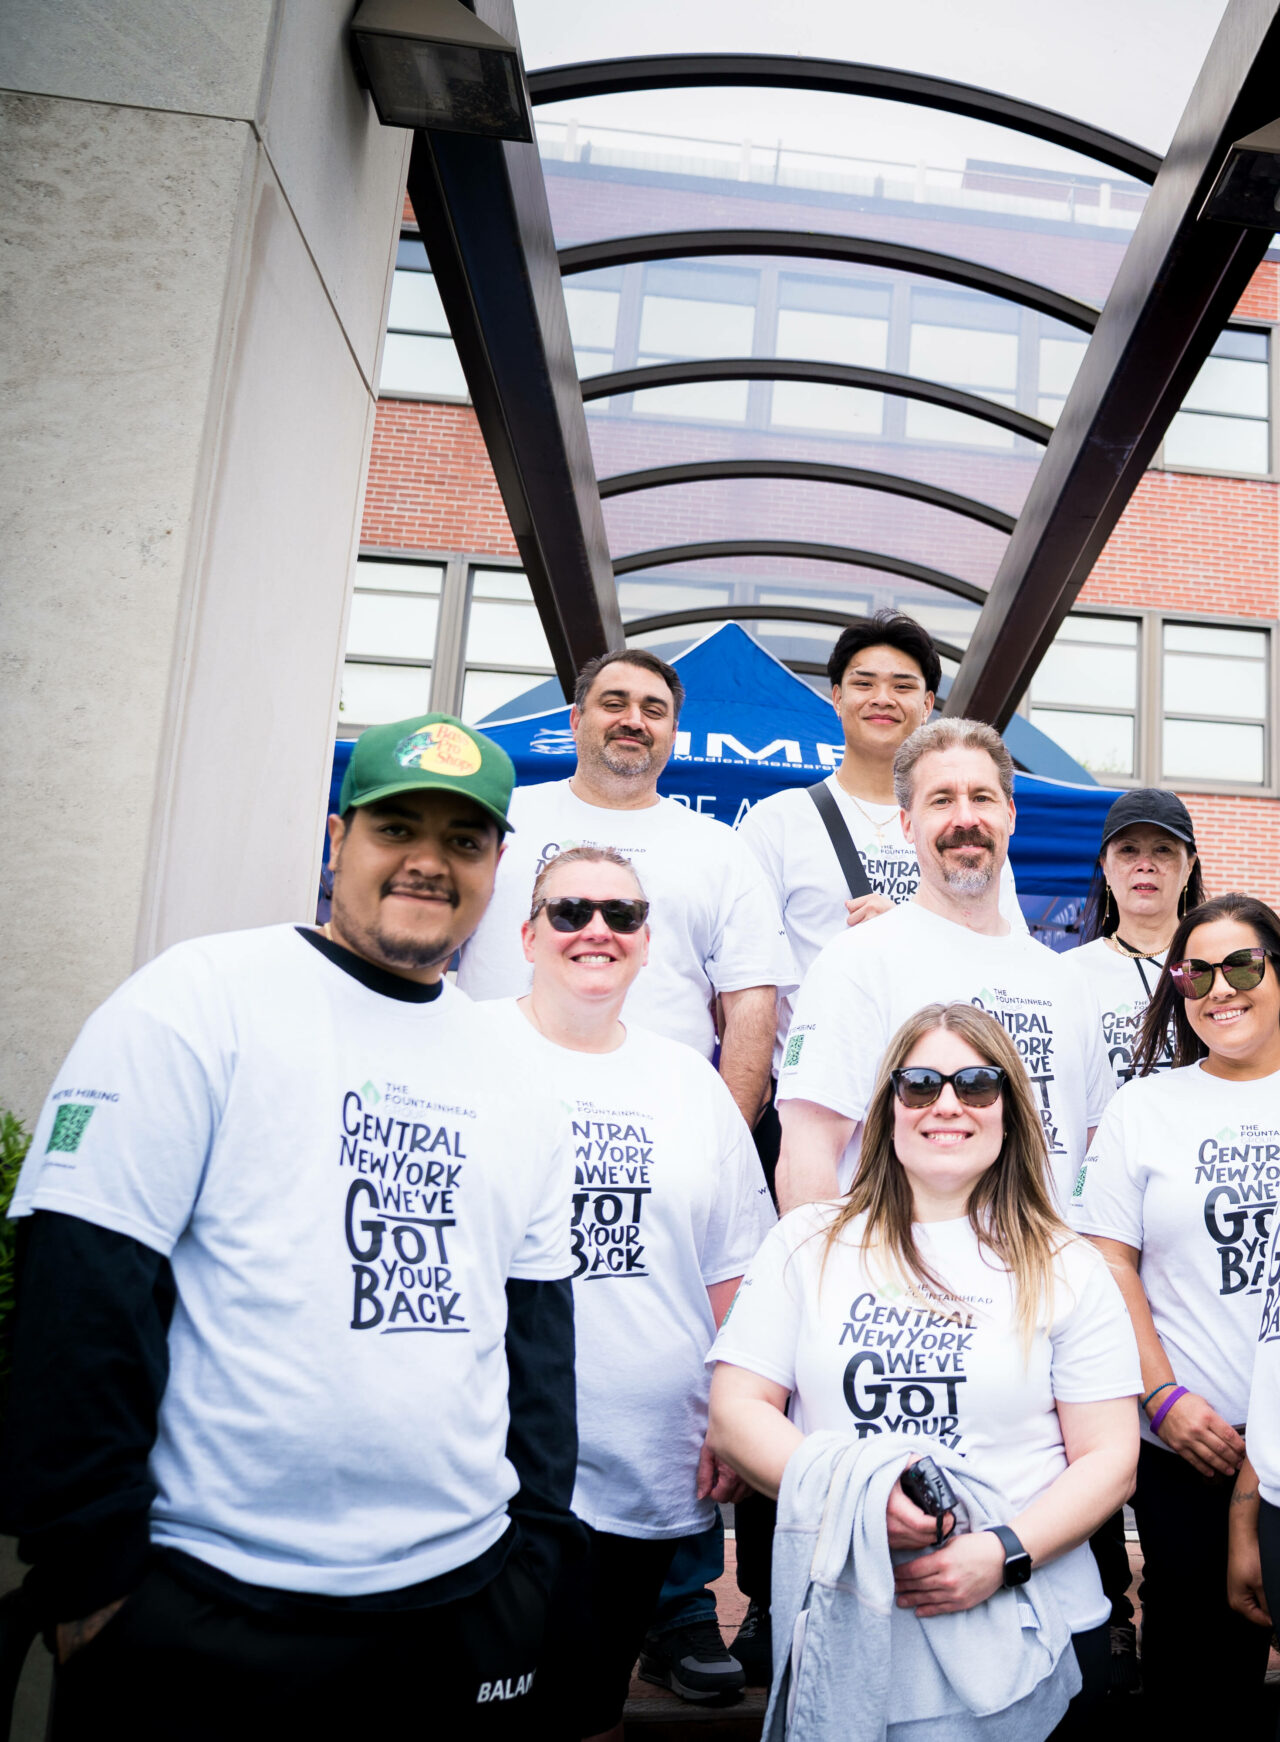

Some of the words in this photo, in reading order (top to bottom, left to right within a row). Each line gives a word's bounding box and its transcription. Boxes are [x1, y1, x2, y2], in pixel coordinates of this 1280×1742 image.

[674, 755, 750, 765] Medical
[858, 851, 920, 878] ENTRA
[993, 988, 1007, 996] THE
[1011, 1034, 1055, 1056] ORK
[386, 1082, 409, 1095] THE
[342, 1090, 467, 1160] CENTRAL
[571, 1120, 654, 1144] NTRAL
[583, 1161, 650, 1185] WE'VE
[379, 1179, 454, 1214] WE'VE
[344, 1178, 457, 1264] GOT
[582, 1222, 640, 1247] YOUR
[380, 1259, 453, 1293] YOUR
[350, 1263, 466, 1330] BACK
[849, 1292, 978, 1330] CENTRAL
[886, 1349, 965, 1375] WE'VE
[842, 1350, 968, 1421] GOT
[883, 1414, 959, 1437] YOUR
[476, 1666, 537, 1704] BALAN
